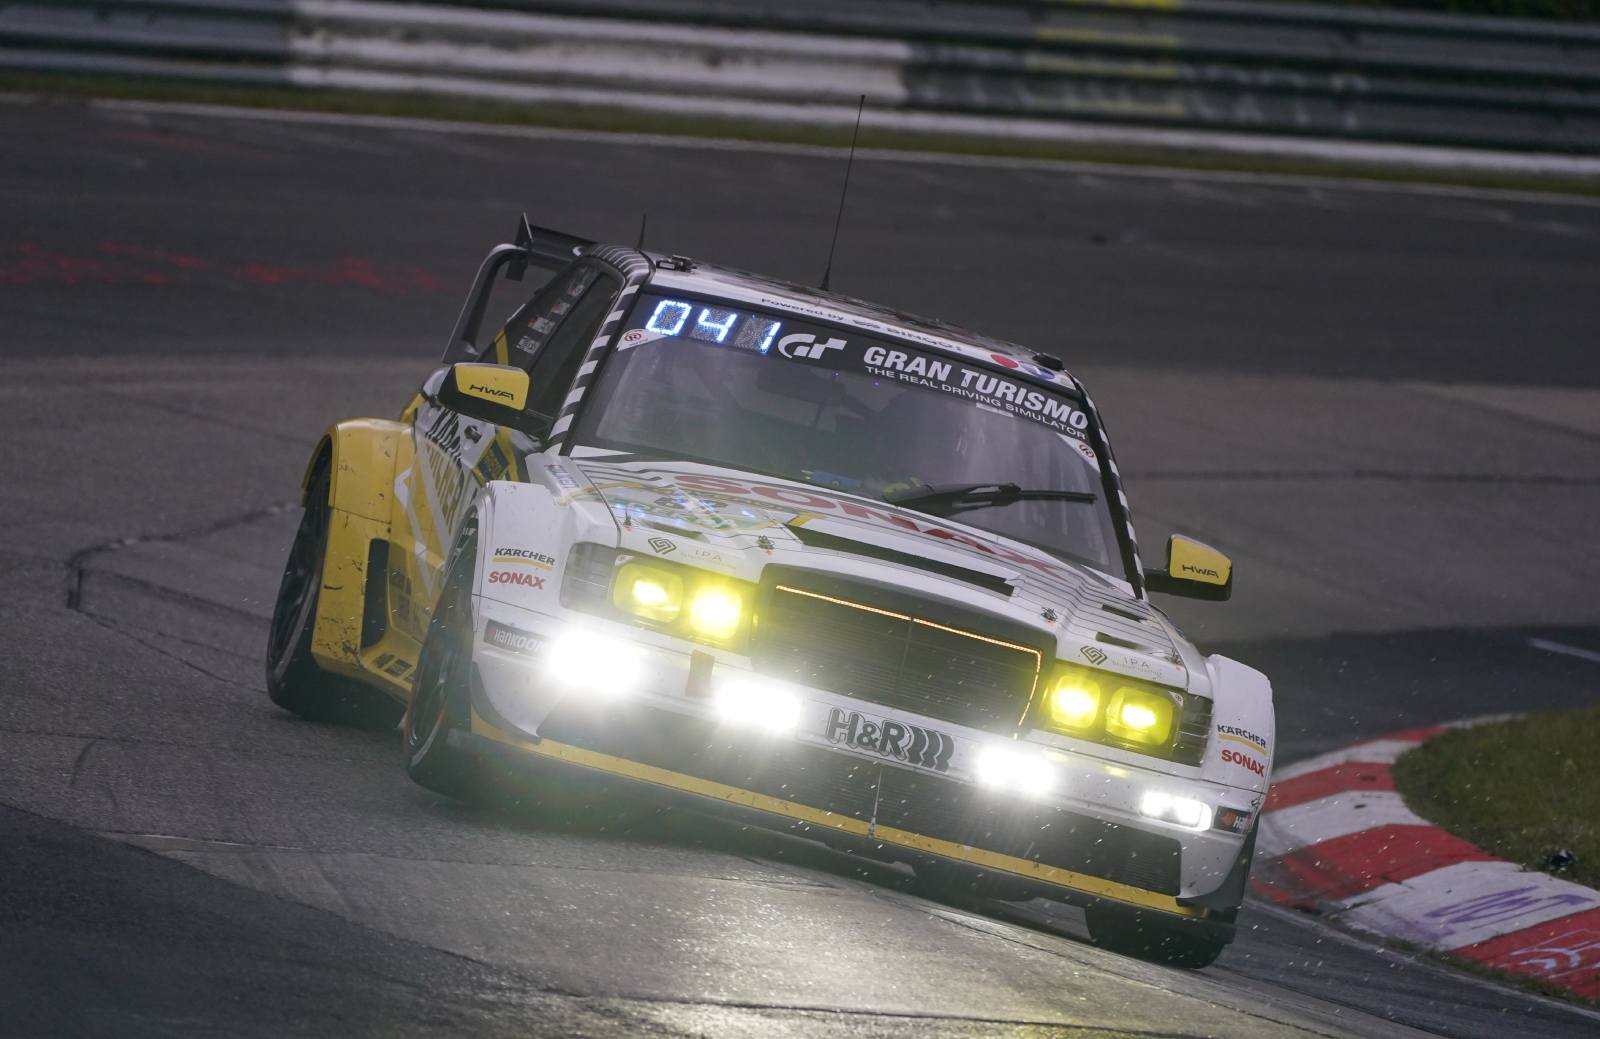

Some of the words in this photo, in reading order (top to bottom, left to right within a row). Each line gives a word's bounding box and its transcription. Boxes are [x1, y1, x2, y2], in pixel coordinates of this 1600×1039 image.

[761, 297, 824, 316] Powered
[827, 312, 844, 321] by
[645, 299, 782, 355] 041
[469, 384, 514, 400] HWA
[863, 346, 953, 382] GRAN
[960, 368, 1089, 430] TURISMO
[865, 365, 895, 378] THE
[899, 373, 939, 389] REAL
[941, 384, 1002, 407] DRIVING
[1005, 403, 1087, 440] SIMULATOR
[673, 474, 1075, 588] SONAX
[494, 547, 556, 566] KÄRCHER
[488, 570, 546, 590] SONAX
[1182, 564, 1219, 578] HWA
[1216, 724, 1267, 749] KÄRCHER
[1221, 749, 1265, 777] SONAX
